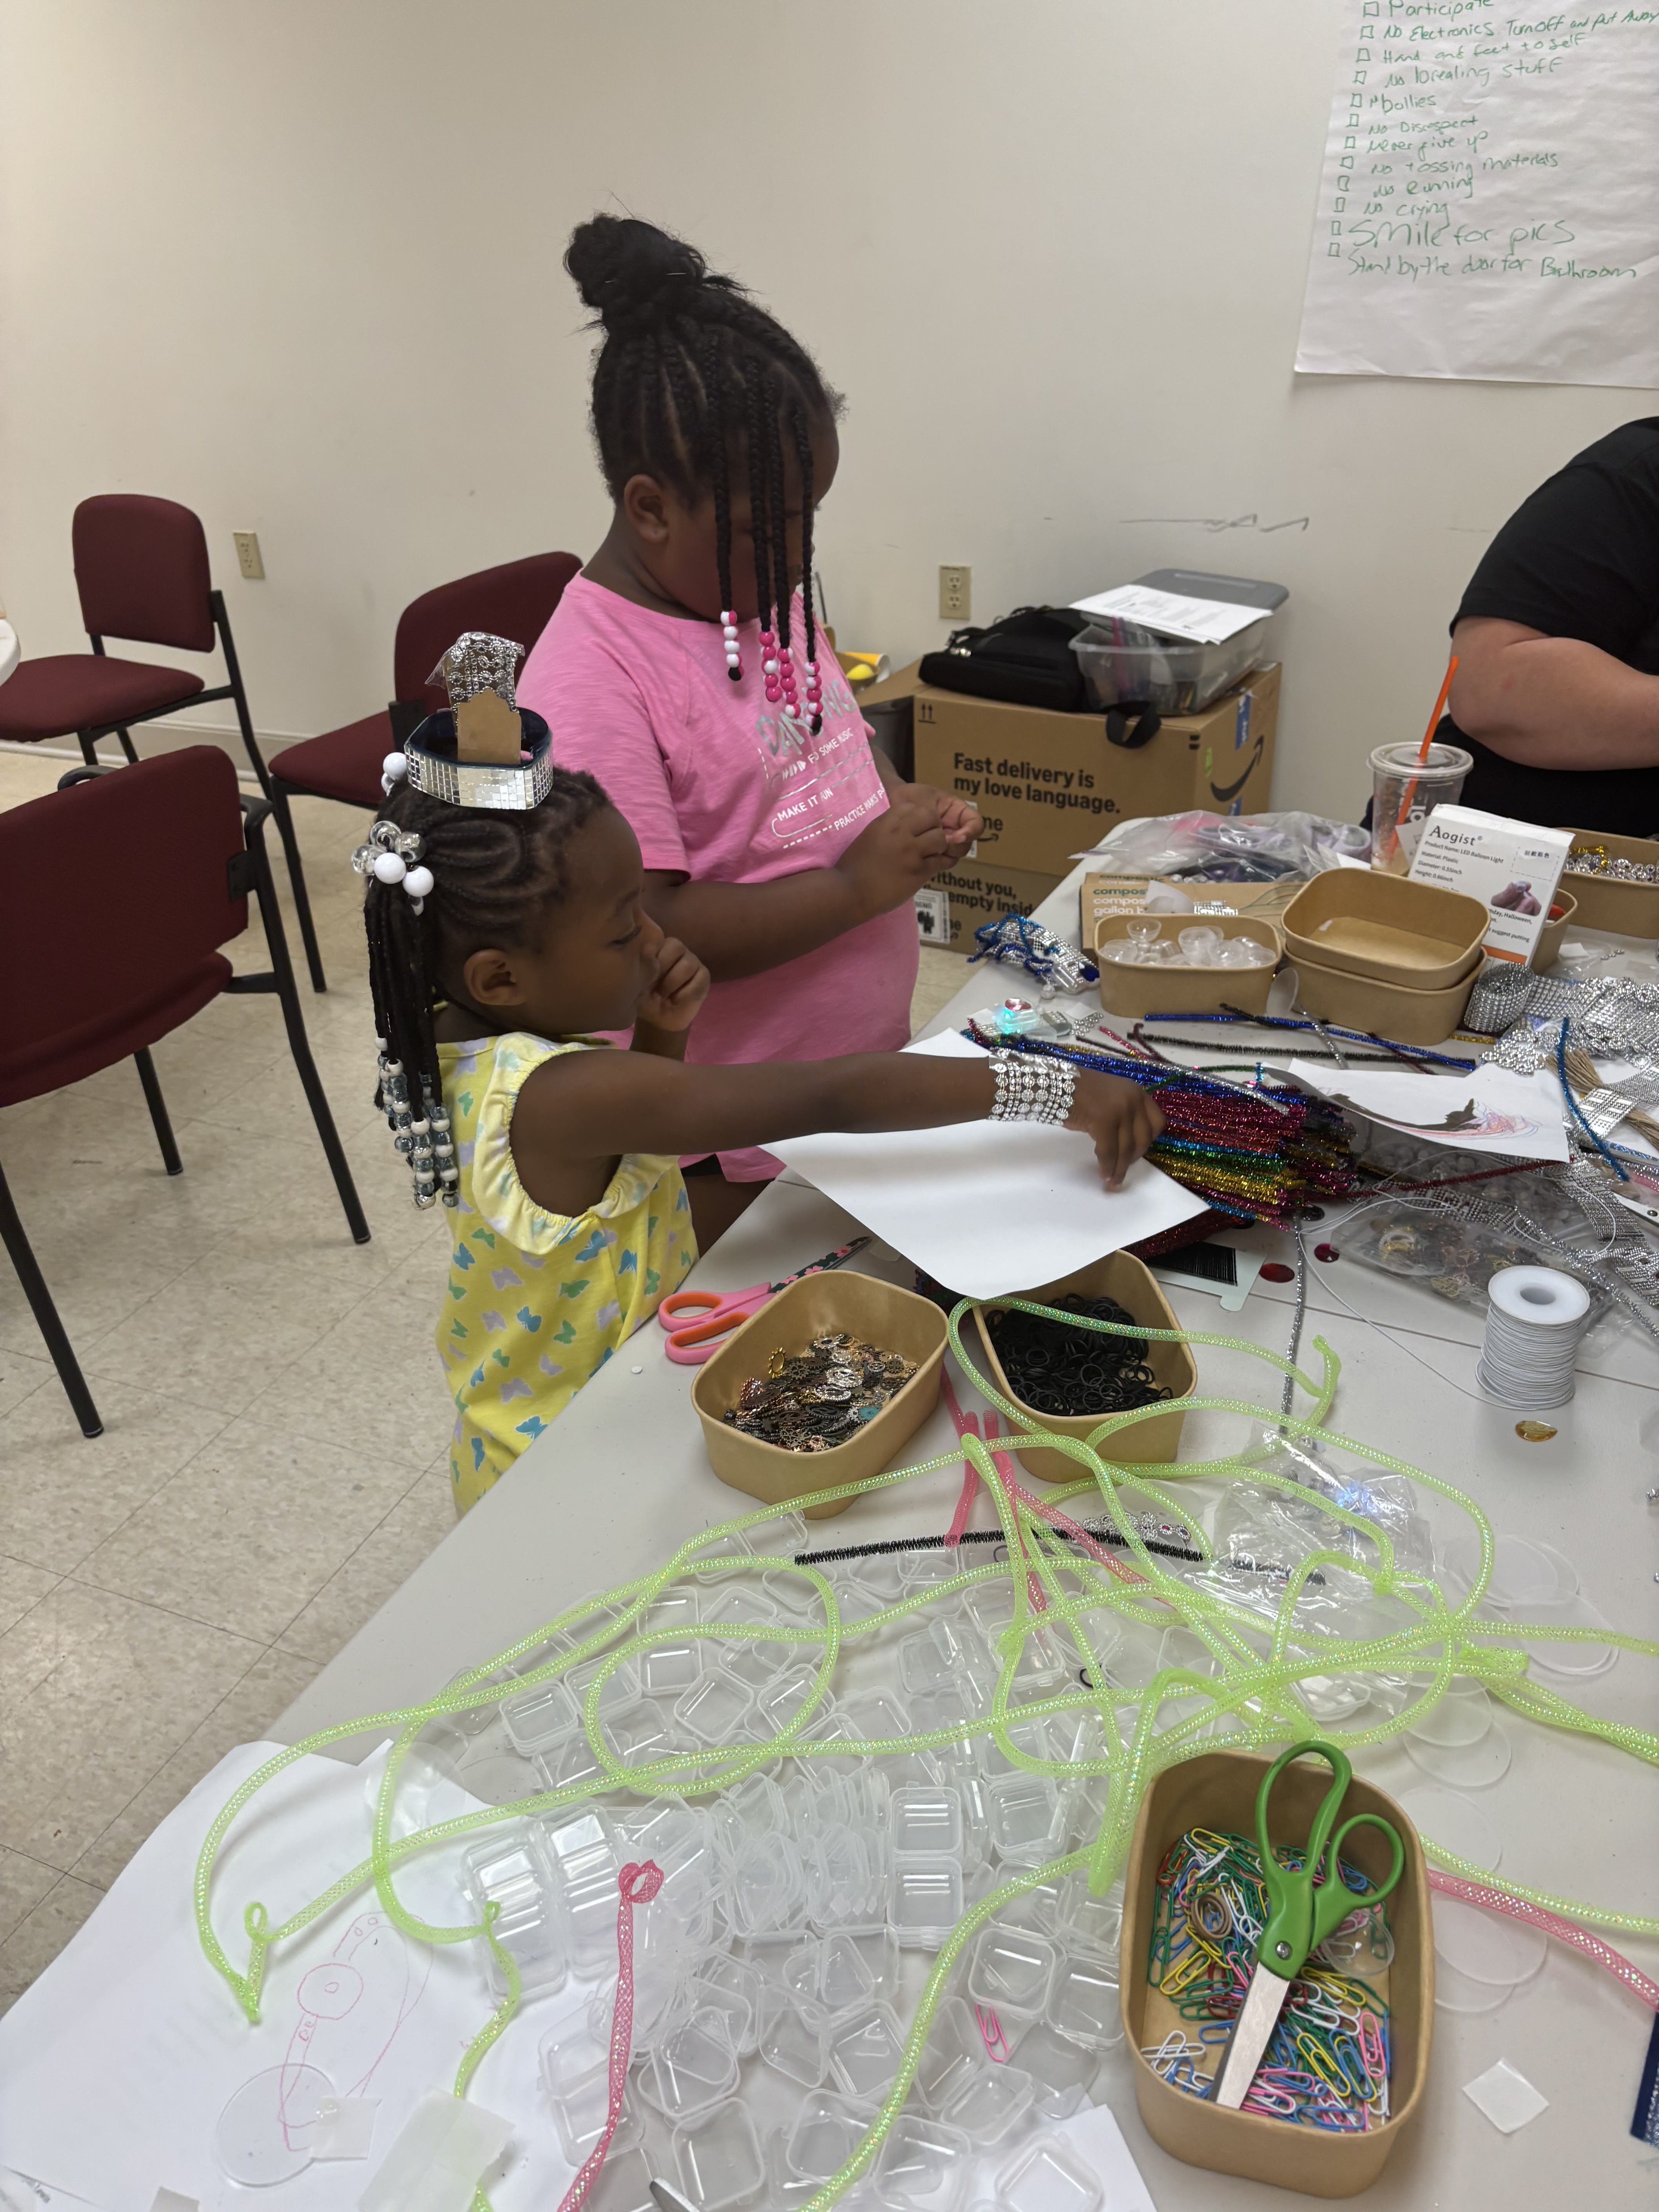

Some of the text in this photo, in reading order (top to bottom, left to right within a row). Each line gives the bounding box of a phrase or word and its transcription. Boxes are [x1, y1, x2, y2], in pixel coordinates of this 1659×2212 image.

[1389, 0, 1494, 22] Participate
[1383, 24, 1402, 39] No
[1409, 22, 1494, 41] Electronics
[1570, 17, 1589, 27] and
[1473, 43, 1509, 57] feet
[1522, 42, 1543, 50] to
[1385, 74, 1405, 88] No
[1368, 125, 1388, 135] No
[1417, 136, 1455, 161] give
[1371, 164, 1393, 174] No
[1405, 160, 1473, 180] tossing
[1373, 184, 1394, 198] No
[1363, 200, 1449, 228] No crying
[1454, 224, 1496, 246] for
[1348, 248, 1391, 275] Stand
[1398, 255, 1418, 283] by
[1420, 256, 1451, 276] the
[1461, 255, 1497, 273] door
[1502, 254, 1533, 271] for
[819, 738, 840, 756] SOME
[954, 752, 1095, 788] Fast delivery is
[954, 776, 1121, 814] my love language.
[777, 802, 807, 821] MAKE
[807, 795, 818, 807] IT
[834, 804, 866, 831] PRACTICE
[1421, 851, 1459, 864] Material: Plastic
[1425, 841, 1443, 849] Product
[1471, 852, 1490, 860] Balloon
[1491, 856, 1504, 864] Light
[1418, 860, 1441, 870] Diameter:
[986, 881, 1017, 900] you,
[948, 892, 994, 912] empty
[997, 897, 1033, 917] insid
[1093, 898, 1147, 906] compos
[1094, 906, 1134, 917] gallon
[1504, 912, 1532, 924] Halloween,
[1492, 928, 1510, 936] suggest
[1511, 934, 1530, 943] putting
